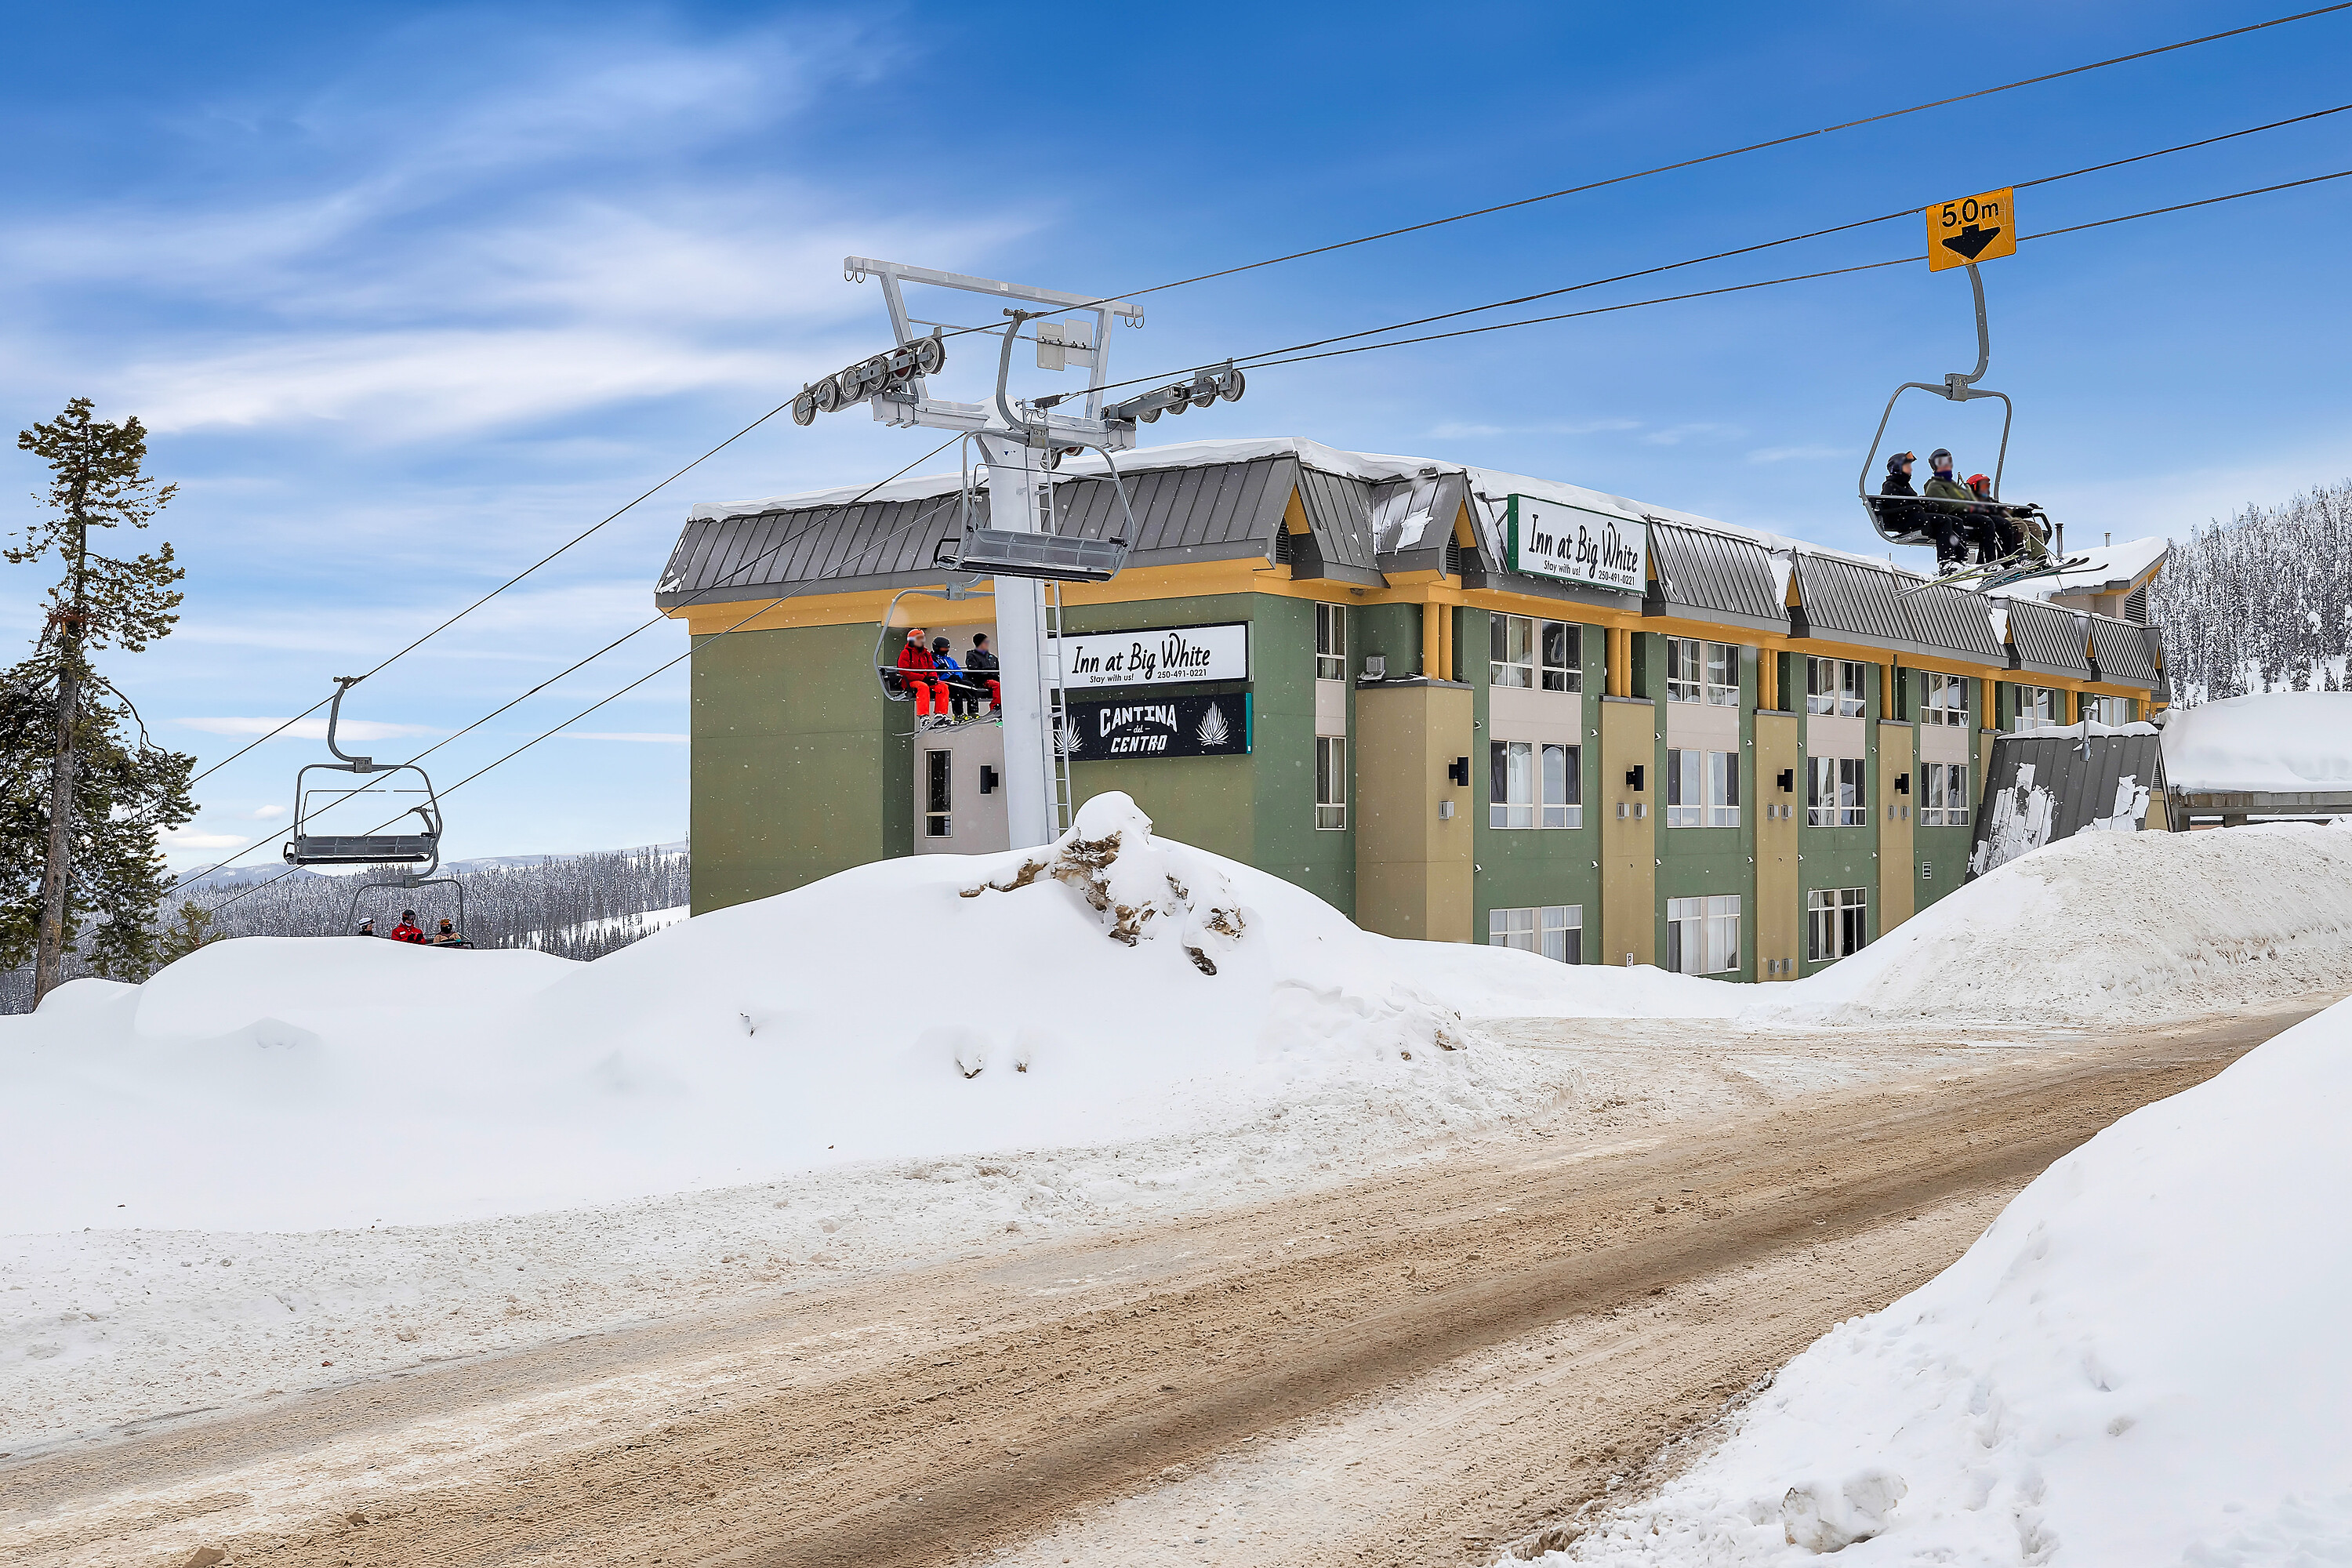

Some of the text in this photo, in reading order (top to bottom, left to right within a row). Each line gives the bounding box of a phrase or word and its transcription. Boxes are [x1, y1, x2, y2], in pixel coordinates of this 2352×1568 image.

[1942, 198, 1999, 227] 5.0m
[1528, 514, 1638, 579] Inn at Big White
[1543, 560, 1635, 586] Stay with us! 250-491-0221
[1072, 632, 1210, 681] Inn at Big White
[1089, 668, 1207, 684] Stay with us! 250-491-0221
[1100, 704, 1178, 738] CANTINA
[1110, 735, 1168, 753] CENTRO
